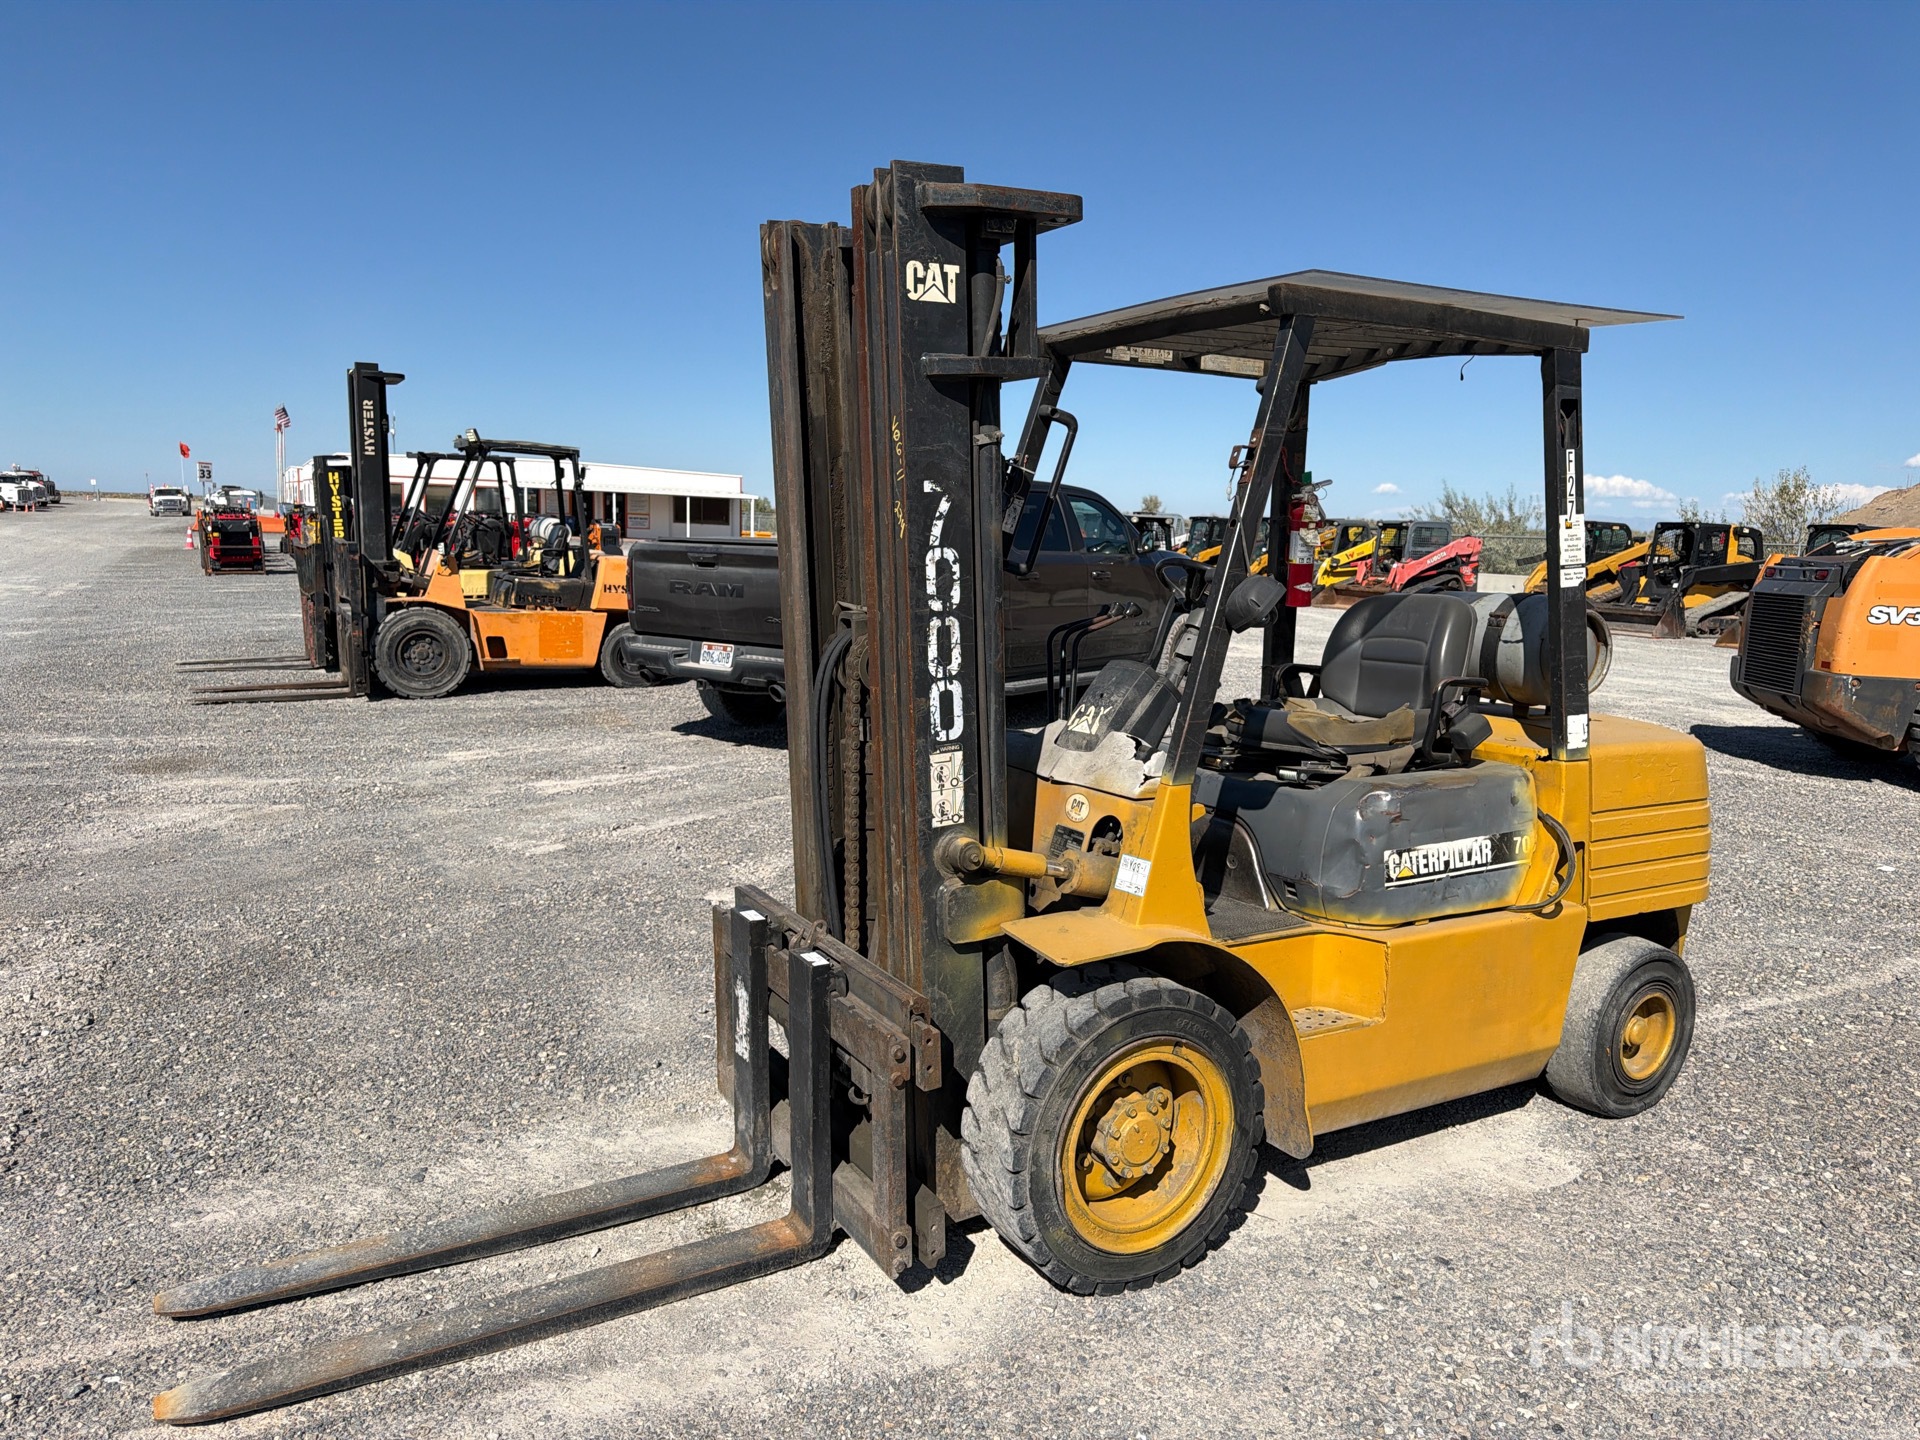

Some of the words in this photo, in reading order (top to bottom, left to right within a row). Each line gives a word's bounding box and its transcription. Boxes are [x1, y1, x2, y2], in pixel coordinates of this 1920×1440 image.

[906, 260, 960, 303] CAT
[363, 399, 375, 456] HYSTER
[200, 470, 212, 479] 33
[603, 584, 627, 594] HYS
[669, 579, 744, 598] RAM
[923, 480, 964, 742] 7000
[1866, 604, 1920, 626] SV3
[1068, 703, 1113, 735] CAT
[940, 744, 960, 752] WARNING
[1071, 798, 1085, 813] CAT
[1388, 838, 1492, 881] CATERPILLAR
